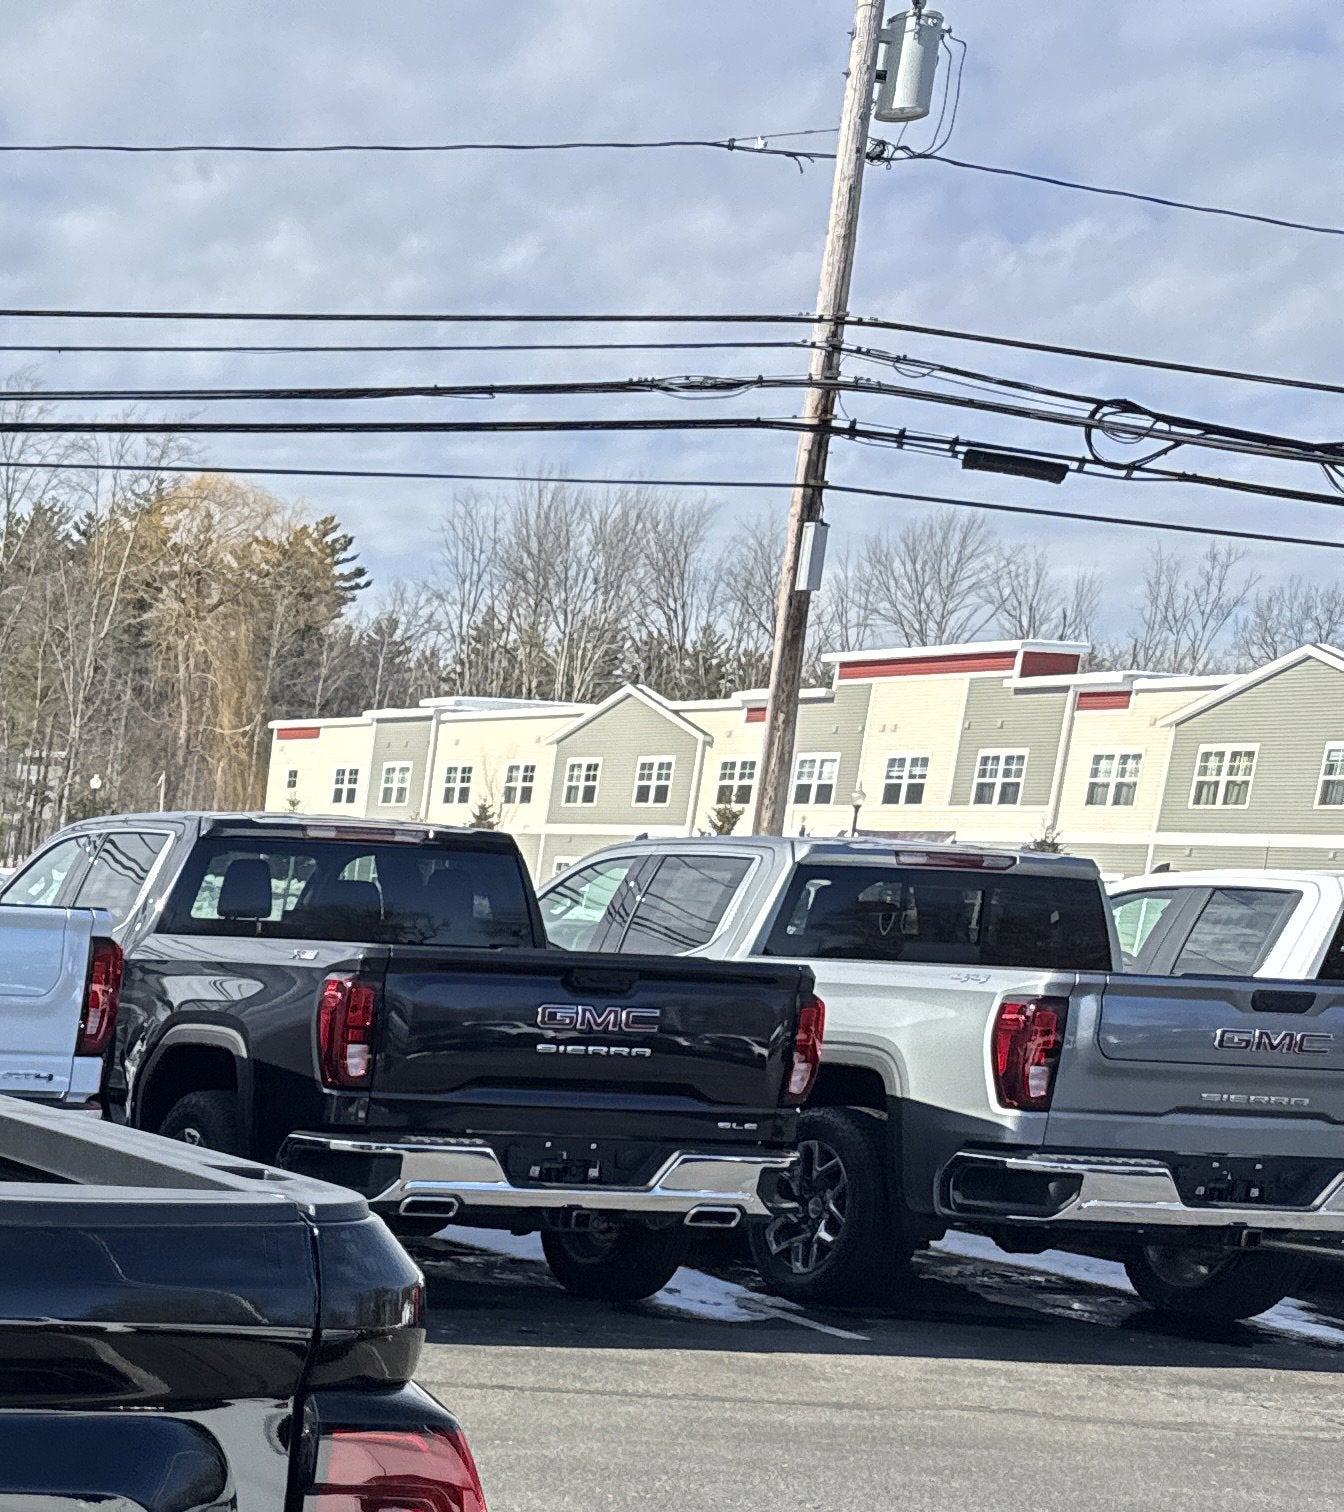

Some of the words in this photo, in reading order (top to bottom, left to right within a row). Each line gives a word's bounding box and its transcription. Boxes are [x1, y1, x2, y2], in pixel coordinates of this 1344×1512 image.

[537, 1004, 660, 1032] GMC
[536, 1043, 652, 1057] SIERRA
[1213, 1027, 1334, 1055] GMC
[1201, 1092, 1310, 1106] SIERRA
